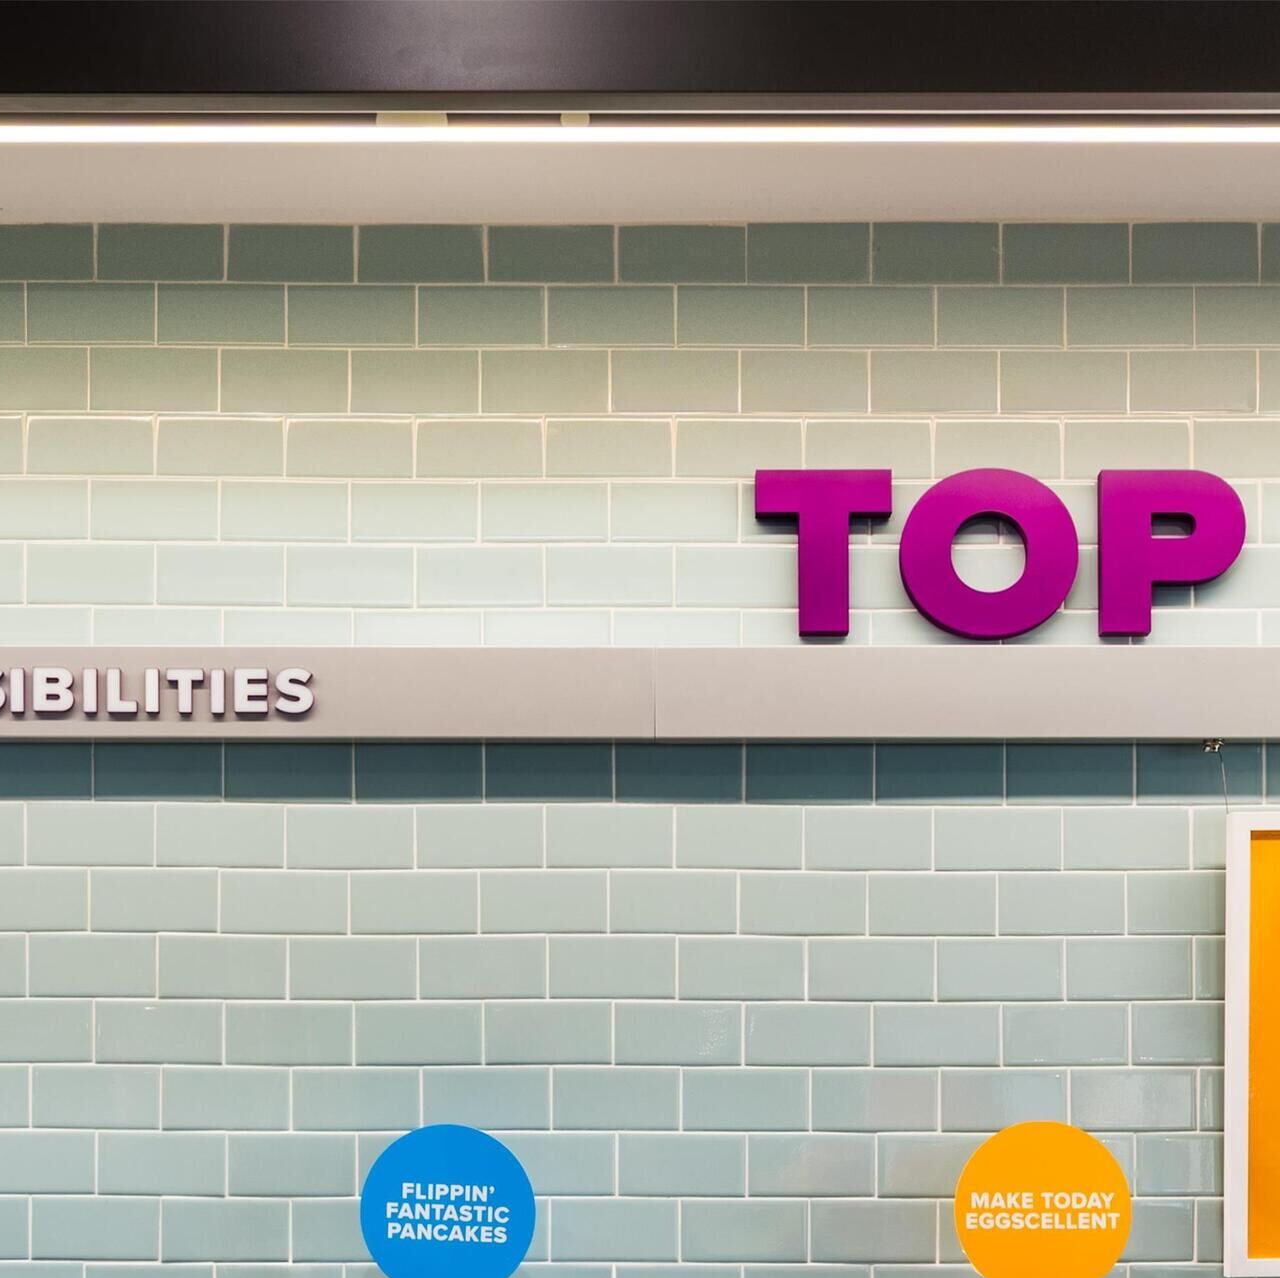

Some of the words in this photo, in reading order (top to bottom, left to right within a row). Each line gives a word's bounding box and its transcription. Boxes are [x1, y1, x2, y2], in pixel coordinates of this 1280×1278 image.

[755, 468, 1247, 641] TOP
[401, 1182, 495, 1202] FLIPPIN’
[970, 1192, 1034, 1209] MAKE
[1041, 1192, 1115, 1209] TODAY
[386, 1201, 510, 1223] FANTASTIC
[965, 1212, 1120, 1230] EGGSCELLENT
[387, 1222, 508, 1243] PANCAKES
